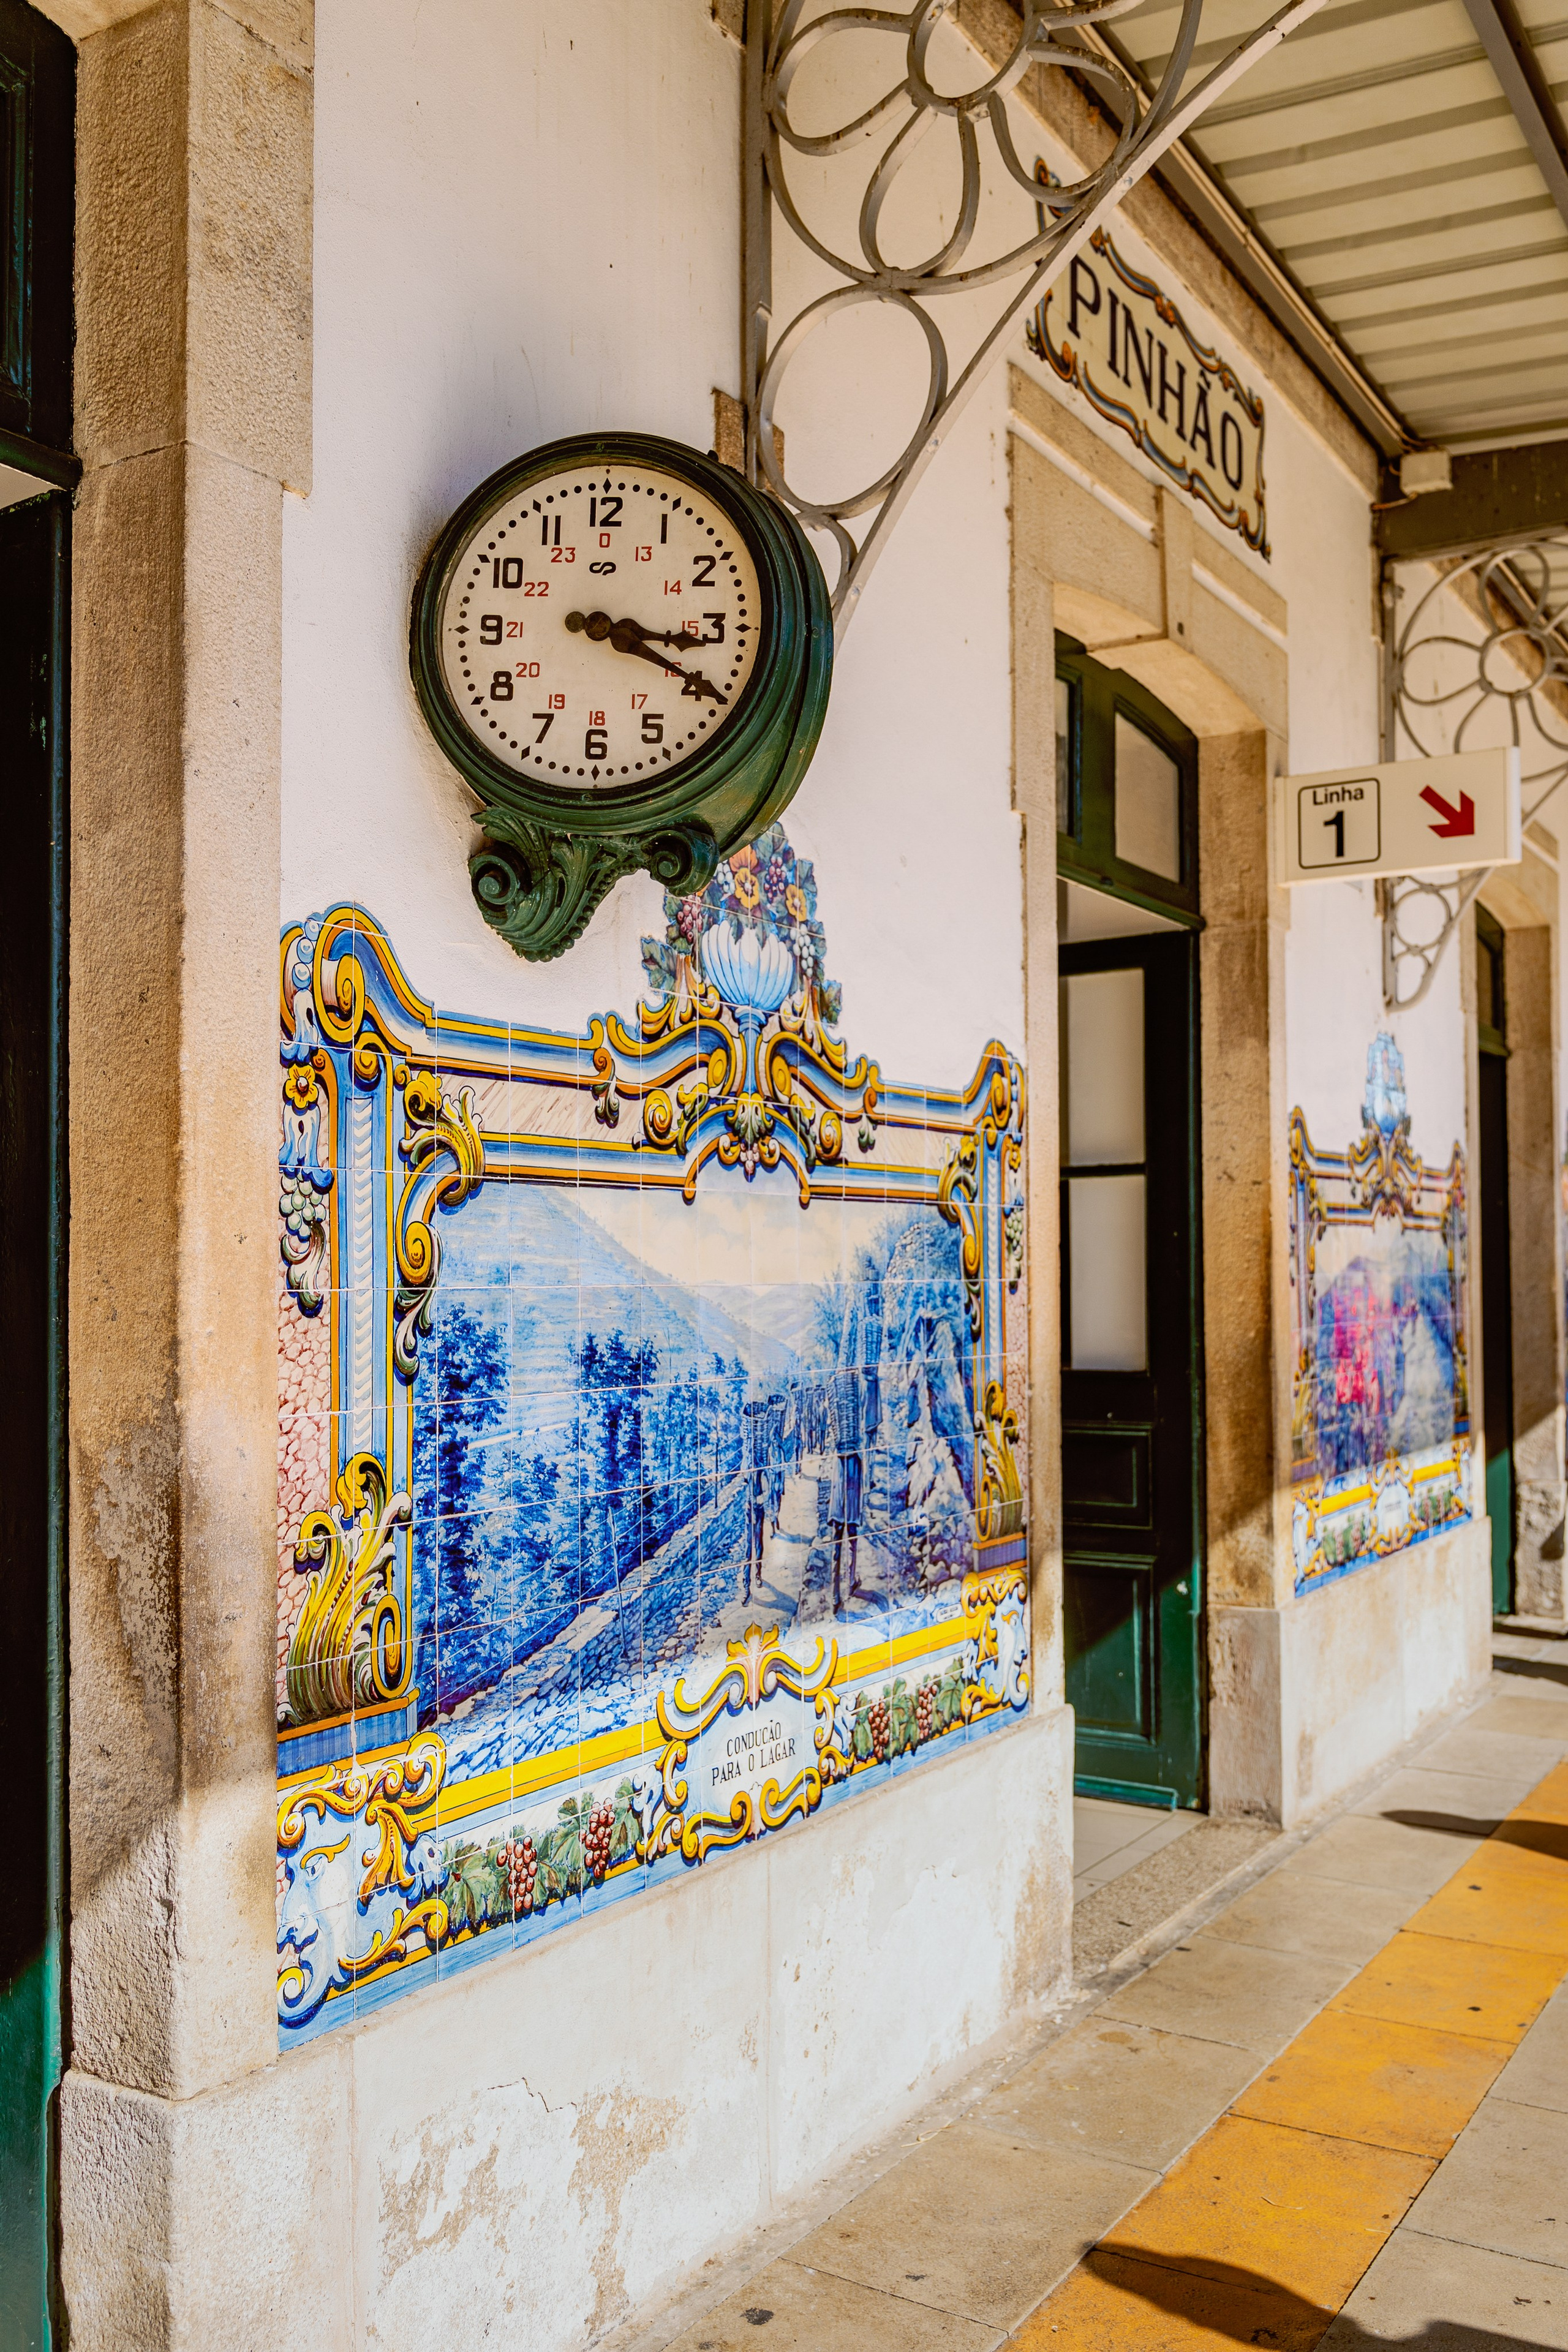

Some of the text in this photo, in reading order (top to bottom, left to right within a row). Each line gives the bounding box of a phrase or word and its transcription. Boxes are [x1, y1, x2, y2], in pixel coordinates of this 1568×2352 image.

[1067, 253, 1244, 491] PINHÃO
[589, 497, 623, 527] 12
[542, 515, 560, 545] 11
[599, 533, 610, 548] 0
[660, 513, 667, 543] 1
[551, 547, 575, 562] 23
[635, 546, 652, 562] 13
[492, 557, 524, 588] 10
[692, 555, 717, 586] 2
[524, 581, 549, 597] 22
[664, 580, 682, 595] 14
[480, 615, 503, 645] 9
[507, 622, 523, 637] 21
[682, 620, 699, 637] 15
[702, 612, 726, 643] 3
[516, 662, 540, 677] 20
[490, 671, 514, 701] 8
[681, 670, 704, 701] 4
[548, 694, 565, 709] 19
[631, 694, 647, 709] 17
[532, 713, 554, 744] 7
[589, 711, 605, 726] 18
[641, 714, 663, 744] 5
[585, 729, 608, 760] 6
[1313, 785, 1364, 805] Linha
[1324, 810, 1344, 858] 1
[712, 1738, 796, 1787] PARA O LAGAR
